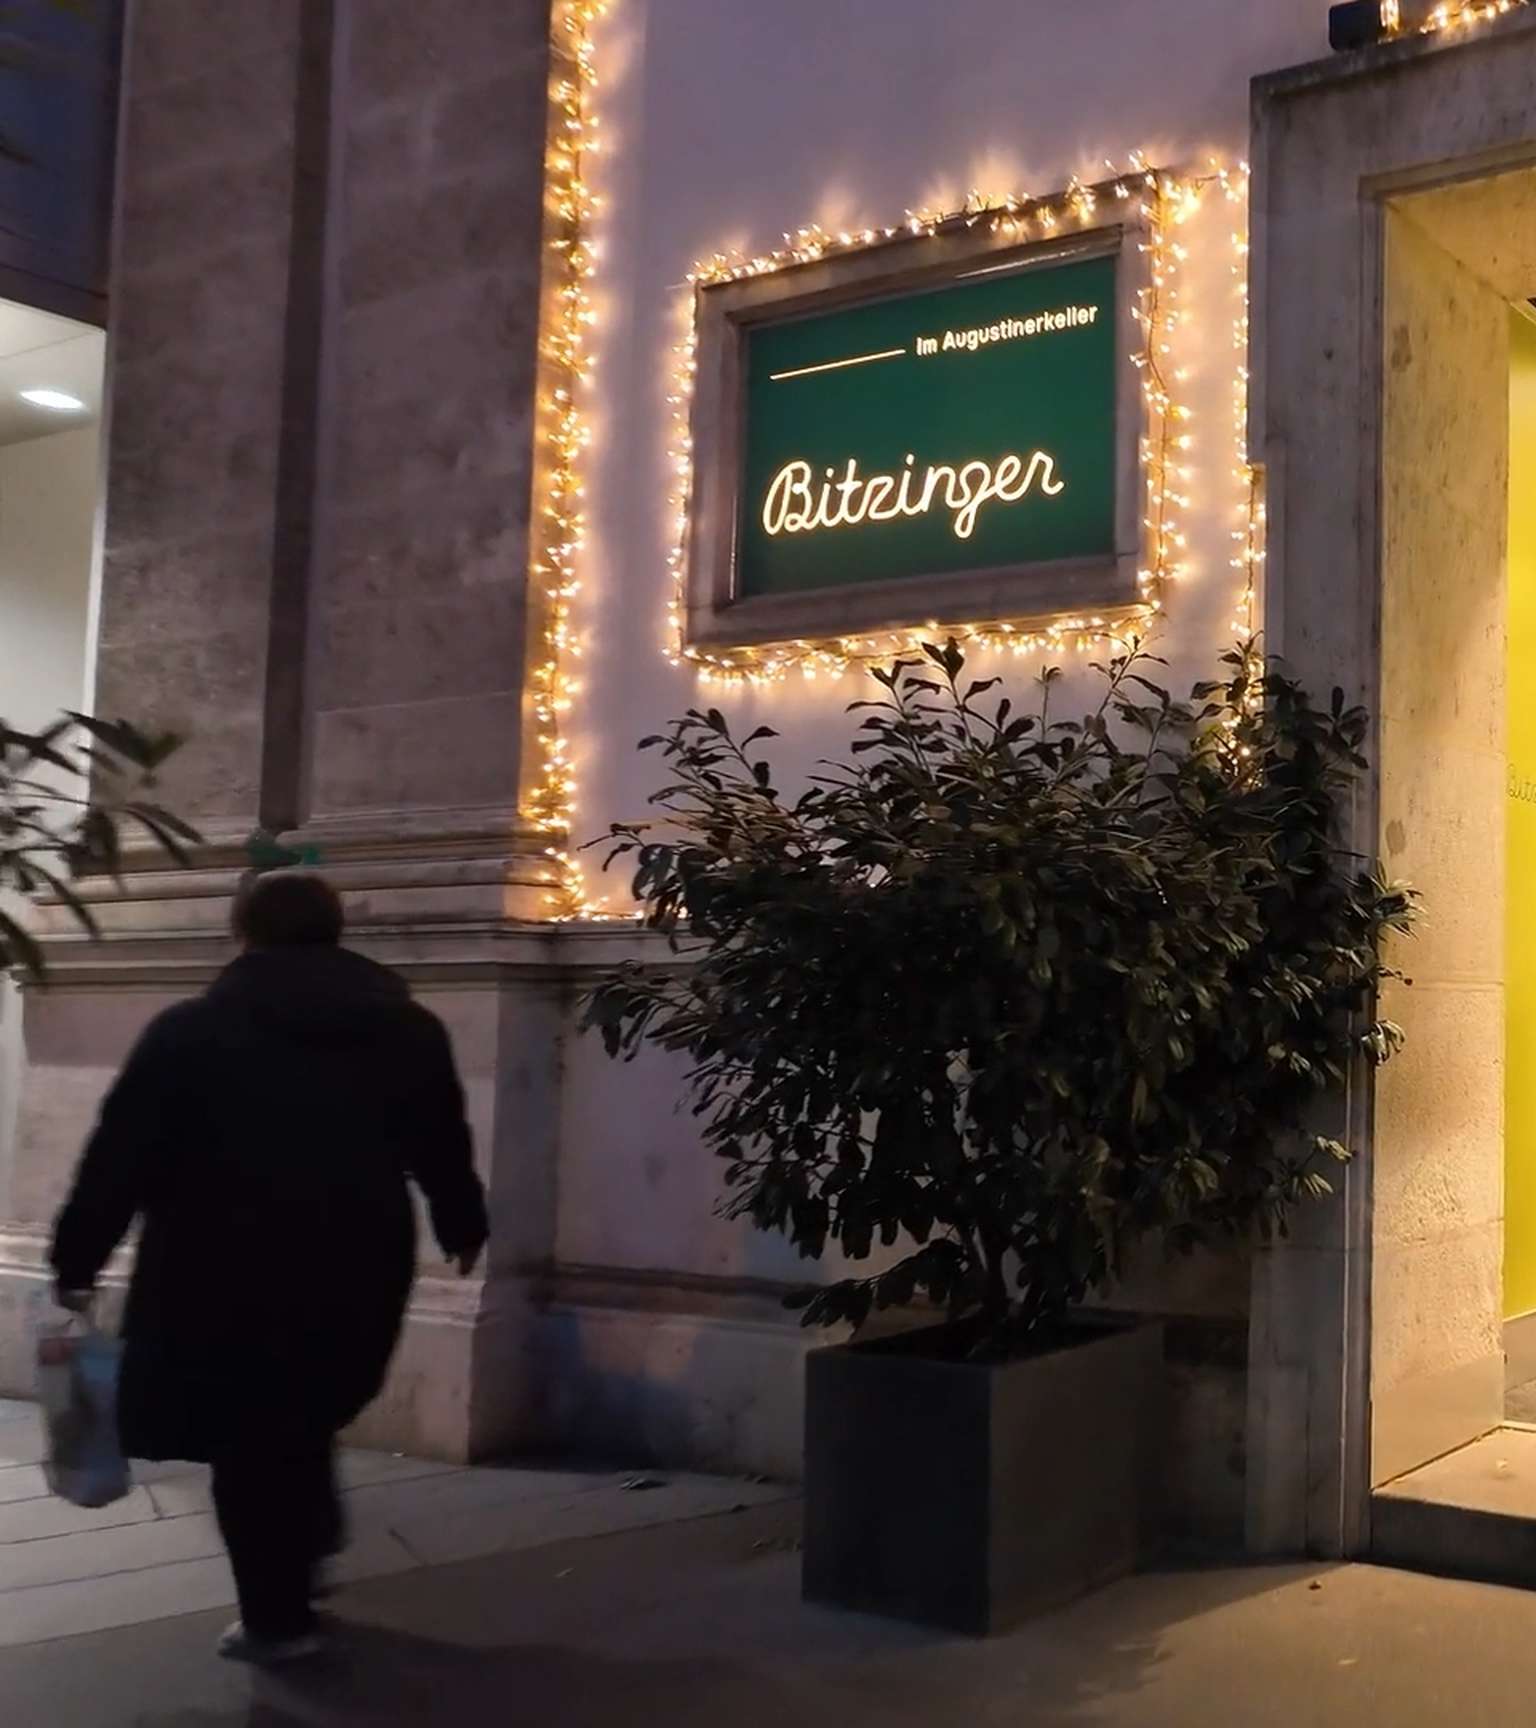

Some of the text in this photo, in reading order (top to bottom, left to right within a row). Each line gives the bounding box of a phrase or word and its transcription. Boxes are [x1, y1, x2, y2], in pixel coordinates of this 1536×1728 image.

[916, 304, 1099, 356] Im Augustinerkeller
[762, 449, 1066, 539] Bitzinger
